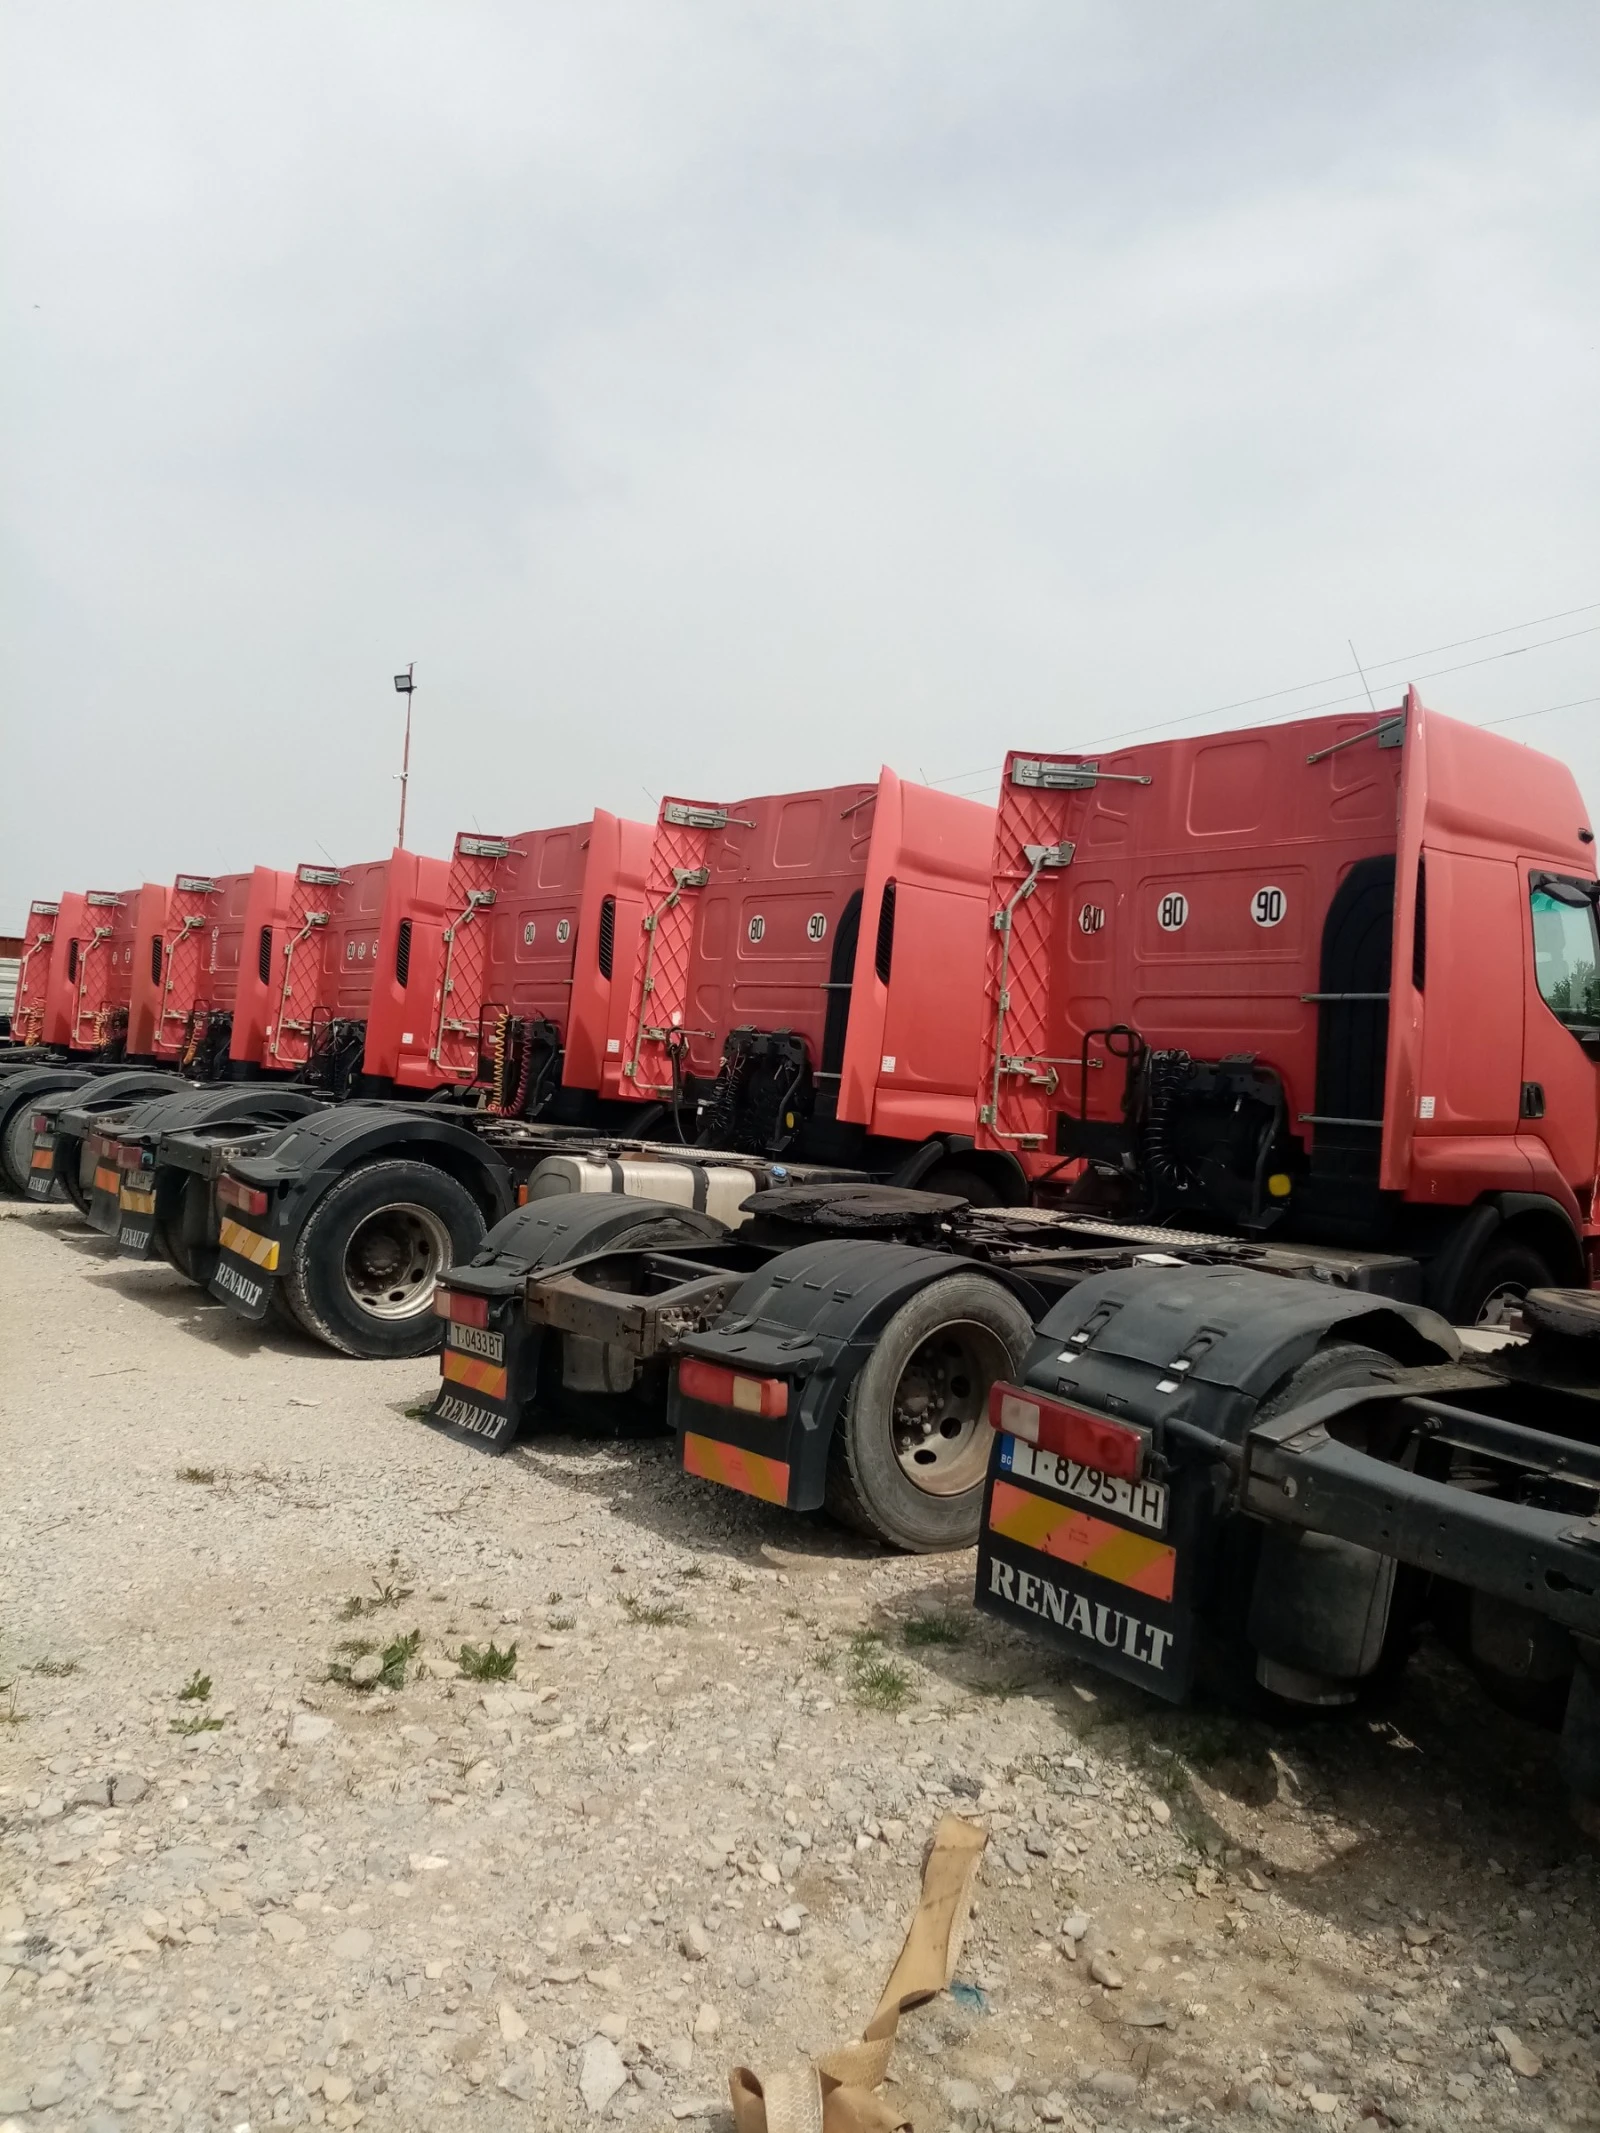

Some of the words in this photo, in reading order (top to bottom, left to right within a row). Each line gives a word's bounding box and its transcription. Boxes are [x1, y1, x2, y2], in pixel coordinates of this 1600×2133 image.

[1162, 897, 1184, 927] 80
[1256, 890, 1281, 923] 90
[558, 922, 568, 940] 90
[750, 918, 763, 940] 80
[809, 916, 824, 938] 90
[215, 1262, 263, 1307] RENAULT
[435, 1395, 508, 1439] RENAULT
[1001, 1453, 1012, 1465] BG
[988, 1556, 1174, 1671] RENAULT
